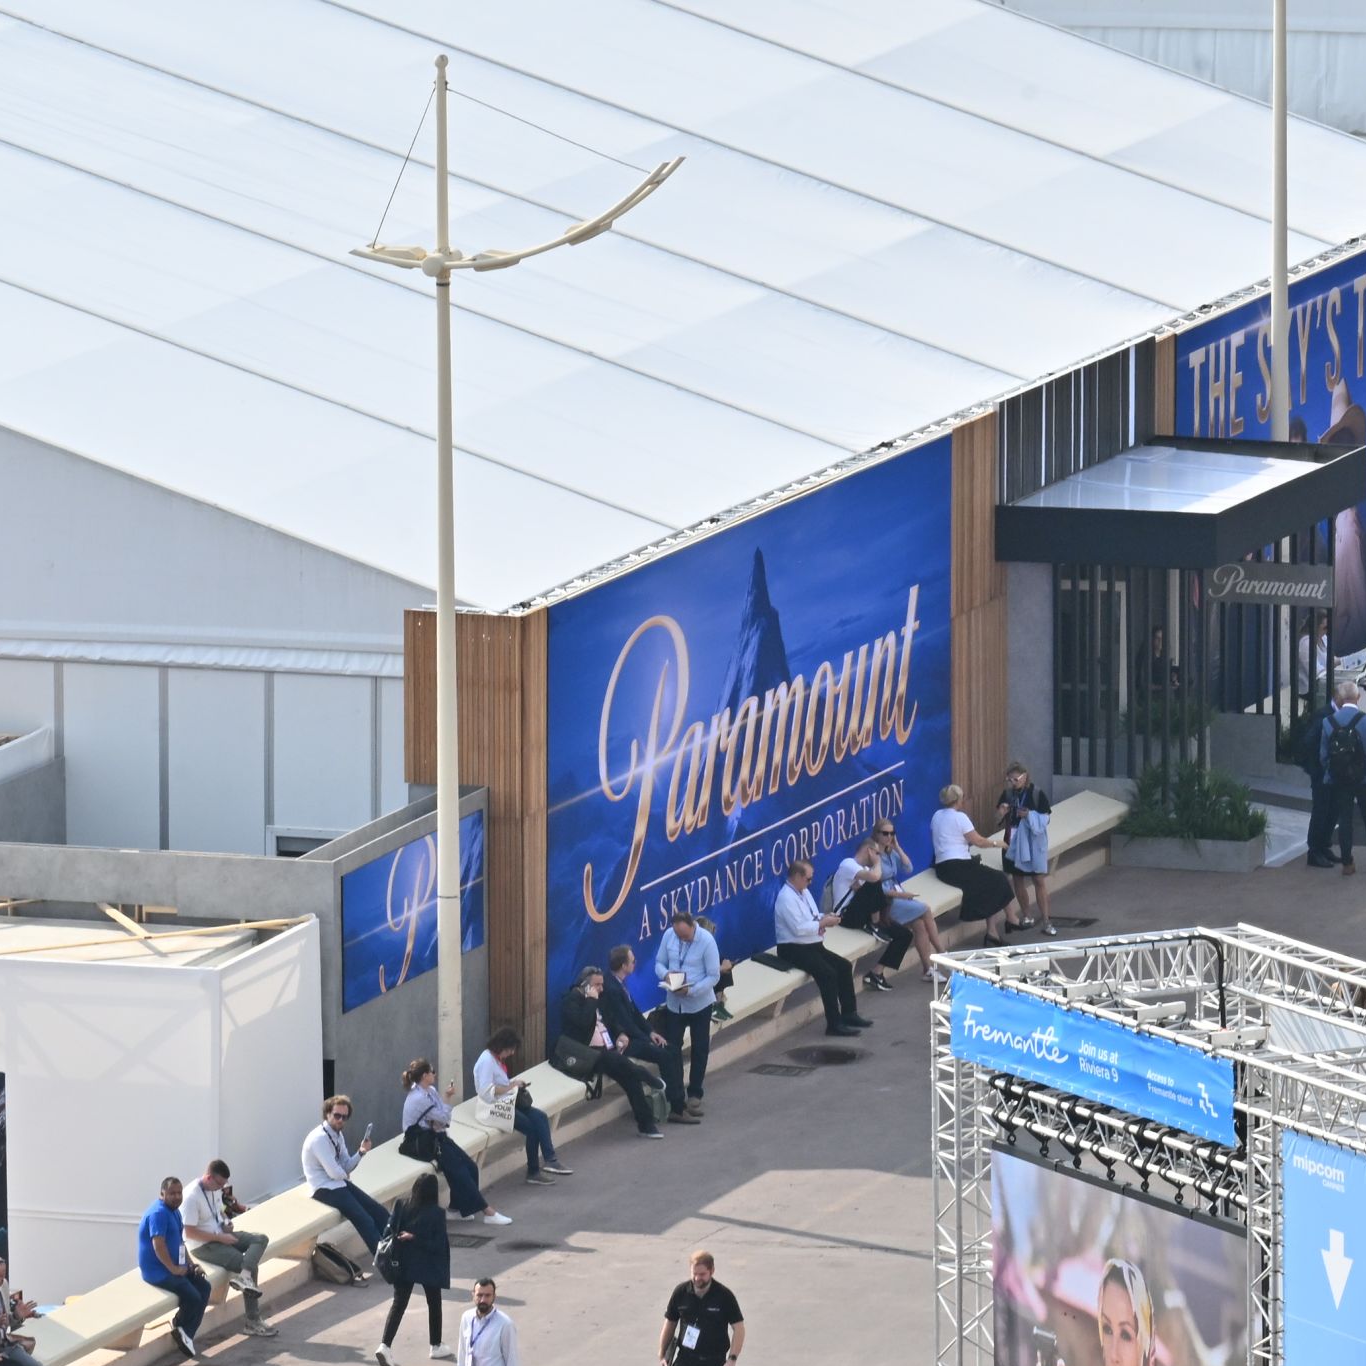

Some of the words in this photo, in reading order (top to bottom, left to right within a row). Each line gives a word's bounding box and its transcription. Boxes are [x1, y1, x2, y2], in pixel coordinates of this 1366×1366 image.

[1188, 335, 1244, 438] THE
[1256, 286, 1342, 424] SY'S
[1208, 563, 1327, 600] Paramount
[584, 583, 920, 922] Paramount
[639, 903, 652, 941] A
[660, 849, 764, 930] SKYDANCE
[772, 779, 905, 876] CORPORATION
[963, 1004, 1069, 1064] Fremantle
[1078, 1040, 1097, 1058] Join
[1098, 1046, 1108, 1061] us
[1109, 1050, 1119, 1065] at
[1079, 1058, 1111, 1080] Riviera
[1111, 1067, 1119, 1083] 9
[1146, 1068, 1167, 1085] Access
[1167, 1075, 1175, 1086] to
[1148, 1083, 1176, 1102] Fremantle
[1177, 1091, 1193, 1107] stand
[490, 1110, 512, 1120] WORLD
[495, 1104, 511, 1113] YOUR
[1293, 1155, 1345, 1183] mipcom
